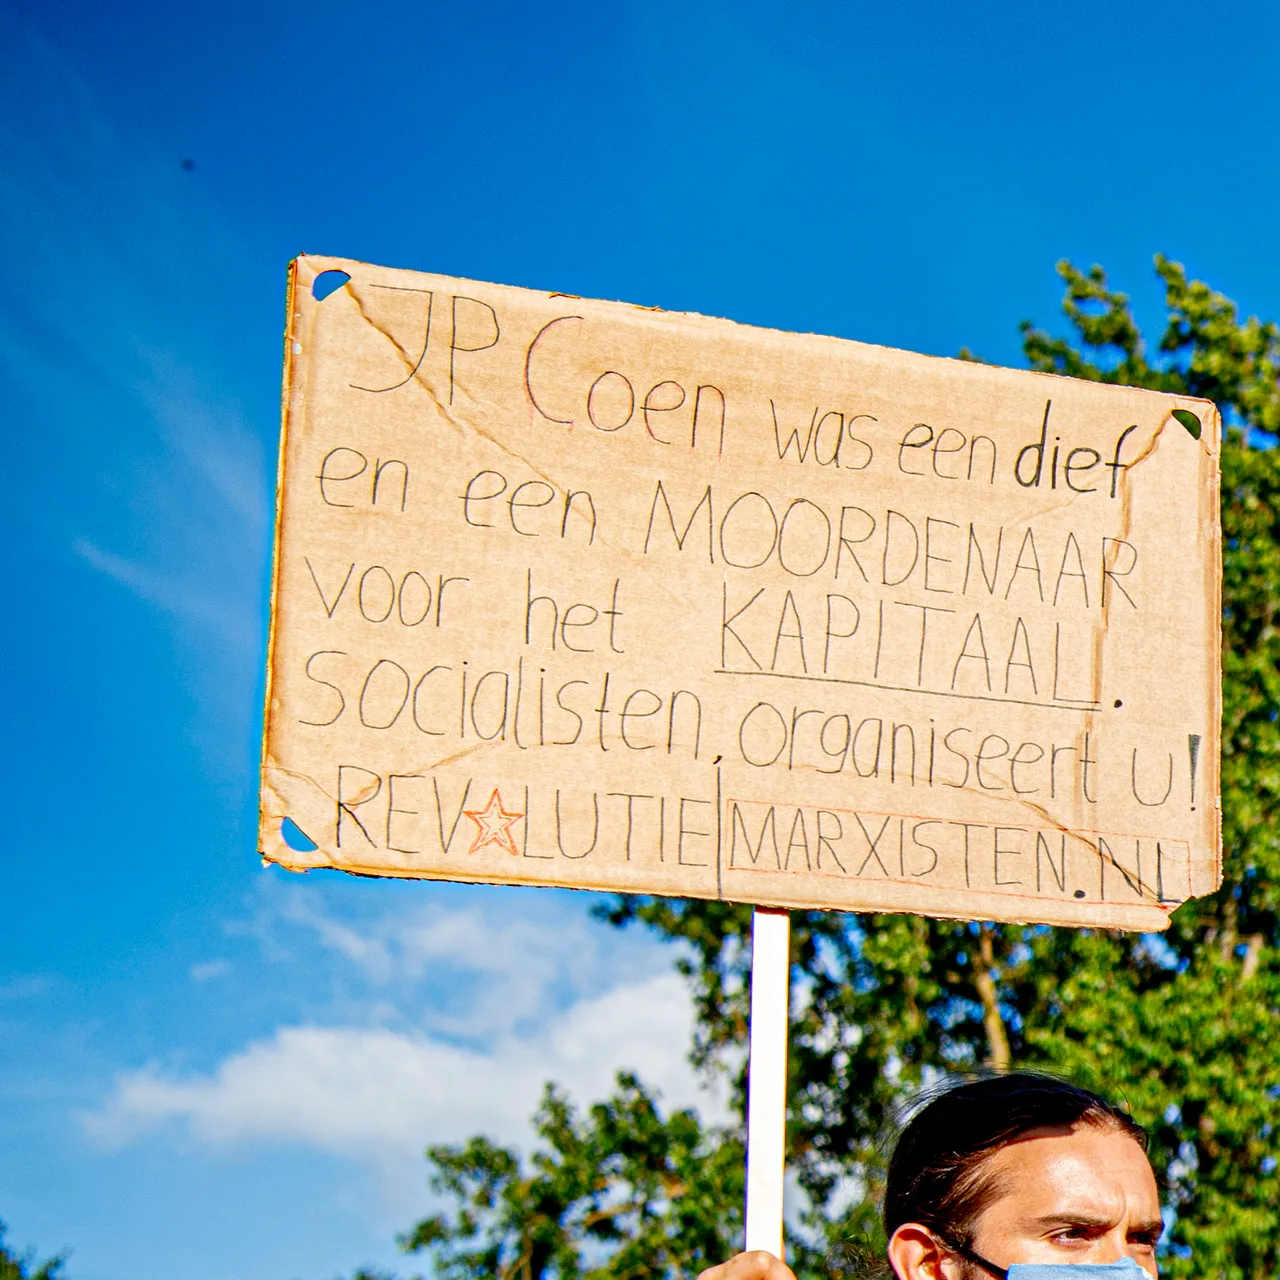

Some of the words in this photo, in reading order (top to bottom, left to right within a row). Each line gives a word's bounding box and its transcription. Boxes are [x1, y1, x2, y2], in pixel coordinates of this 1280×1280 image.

[349, 284, 499, 405] JP
[525, 316, 725, 456] Coen
[770, 399, 878, 471] was
[899, 423, 994, 484] een
[1014, 399, 1137, 498] dief
[315, 447, 408, 512] en
[458, 470, 597, 545] een
[644, 481, 1137, 609] MOORDENAAR
[304, 556, 470, 627] voor
[526, 568, 624, 653] het
[721, 581, 1123, 708] KAPITAAL.
[739, 702, 1097, 804] organiseert
[731, 802, 1183, 903] MARXISTEN.NL
